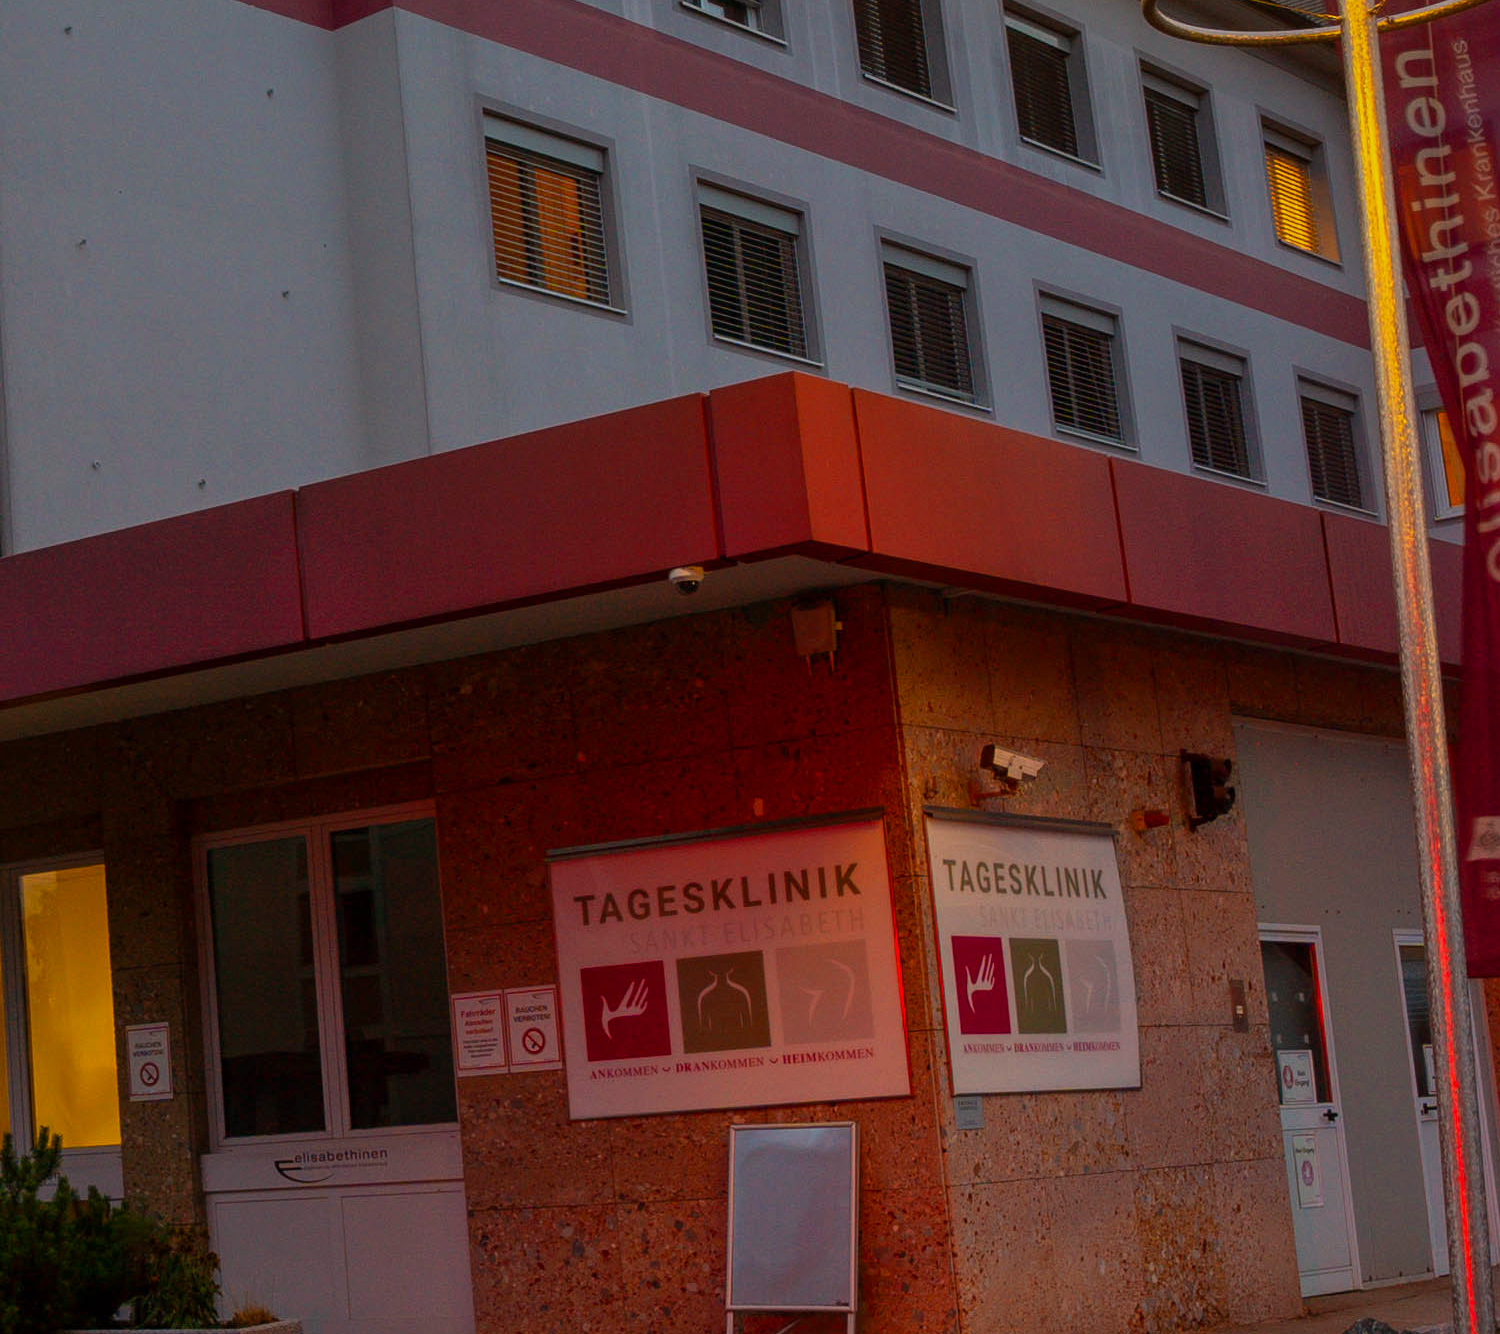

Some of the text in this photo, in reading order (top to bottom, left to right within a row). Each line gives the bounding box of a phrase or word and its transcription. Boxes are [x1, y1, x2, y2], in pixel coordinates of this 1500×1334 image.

[1450, 39, 1496, 200] Krankenhaus
[573, 862, 861, 926] TAGESKLINIK
[942, 859, 1107, 899] TAGESKLINIK
[629, 908, 865, 955] SANKT ELISABETH
[589, 1047, 874, 1081] ANKOMMEN DRANKOMMEN HEIMKOMMEN
[294, 1148, 388, 1164] elisabethinen
